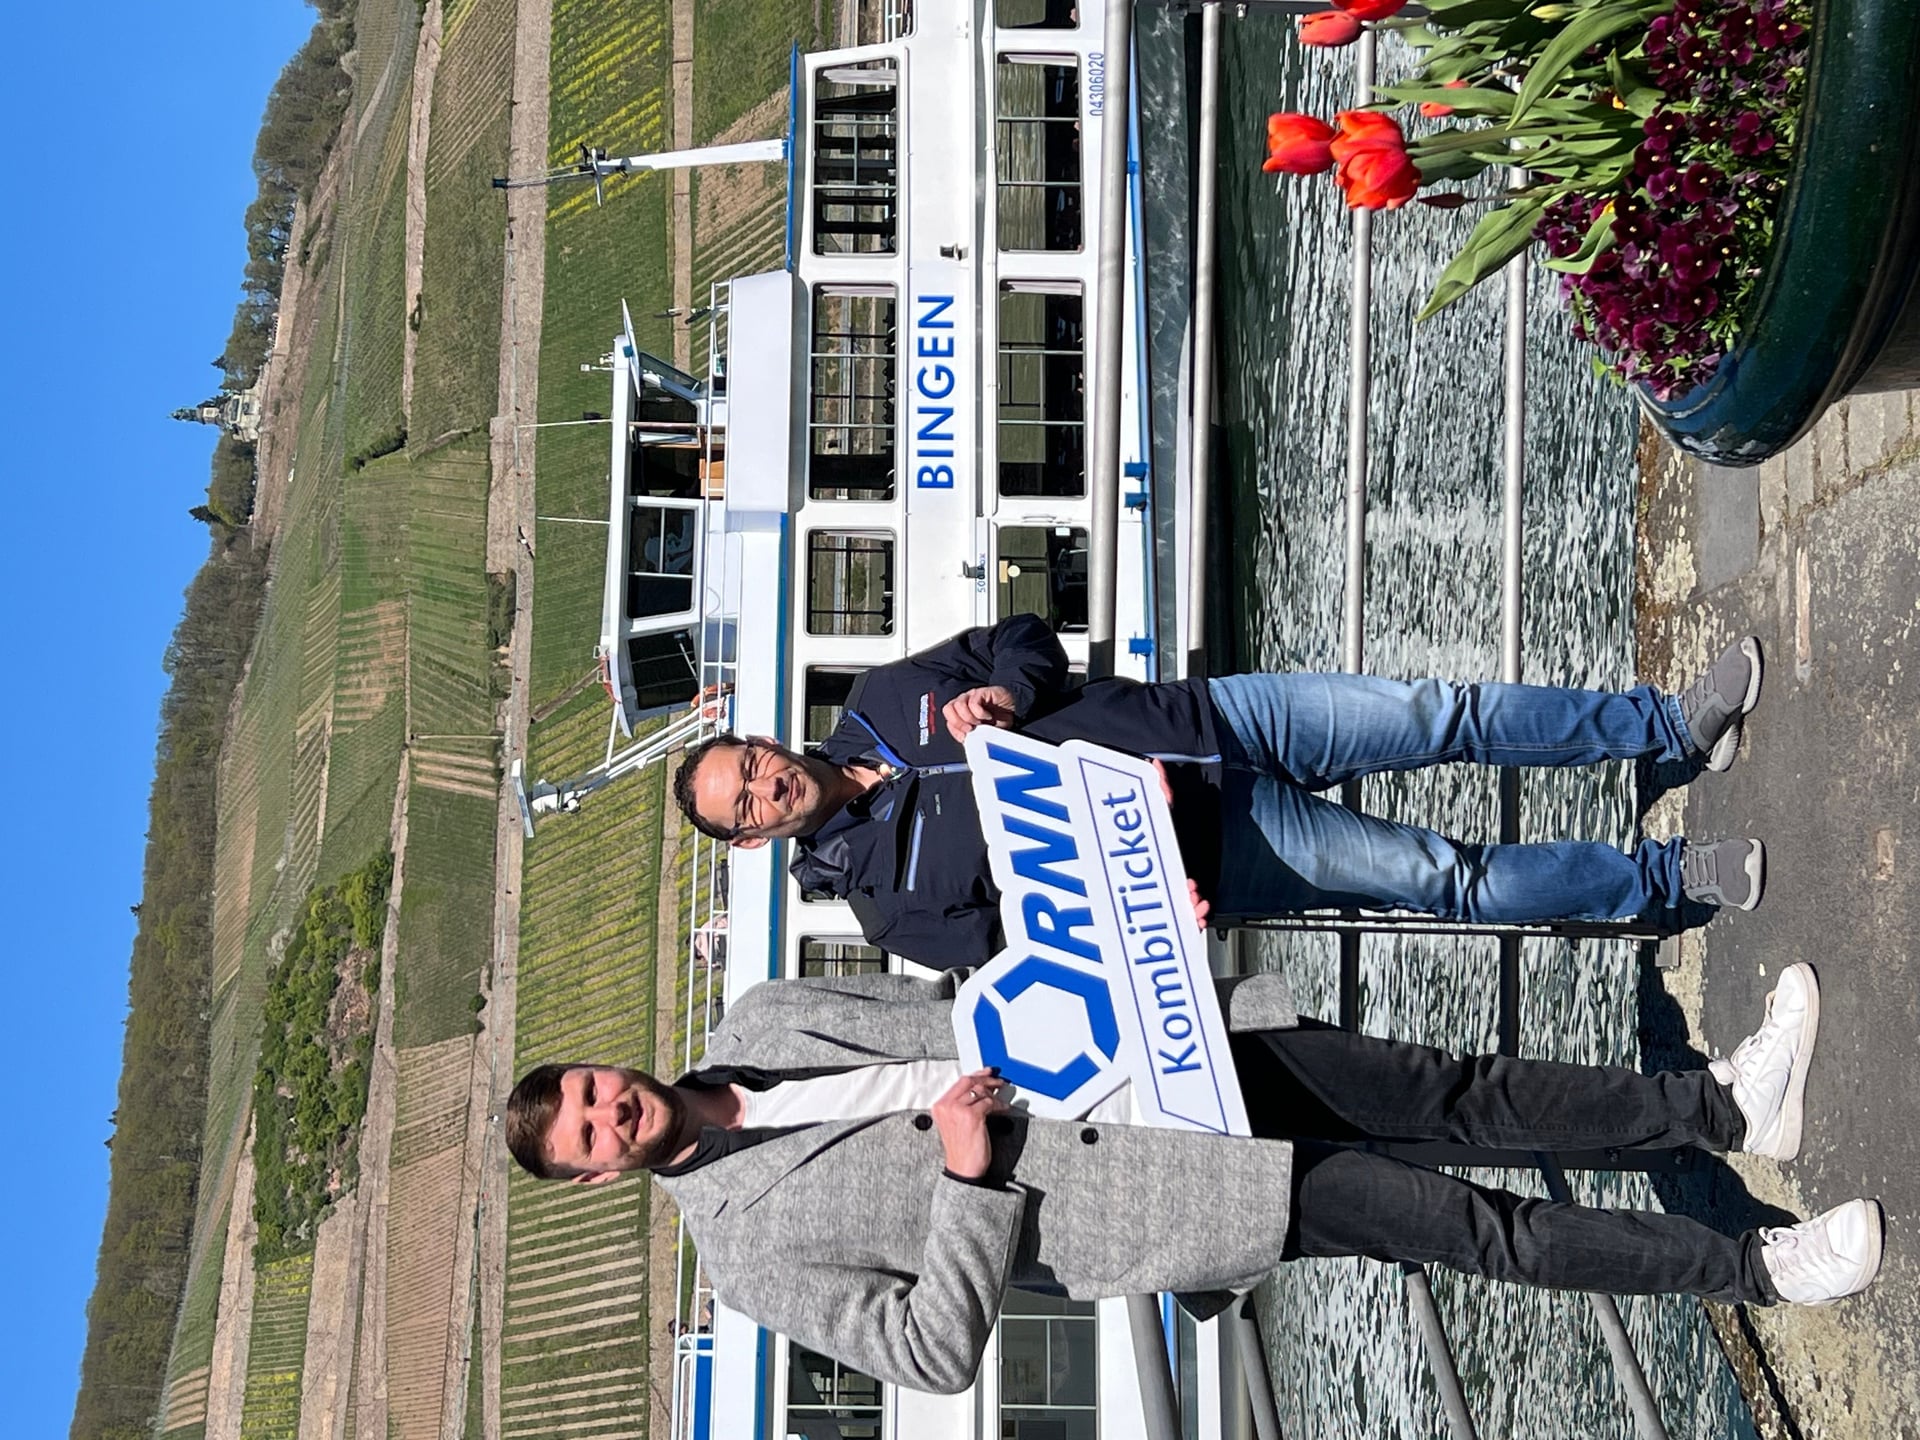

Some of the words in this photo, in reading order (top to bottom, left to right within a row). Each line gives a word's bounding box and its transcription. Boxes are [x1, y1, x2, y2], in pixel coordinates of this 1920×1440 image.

[1088, 51, 1105, 117] 04306020
[916, 295, 955, 489] BINGEN
[986, 742, 1103, 964] RNN
[1101, 788, 1201, 1075] KombiTicket
